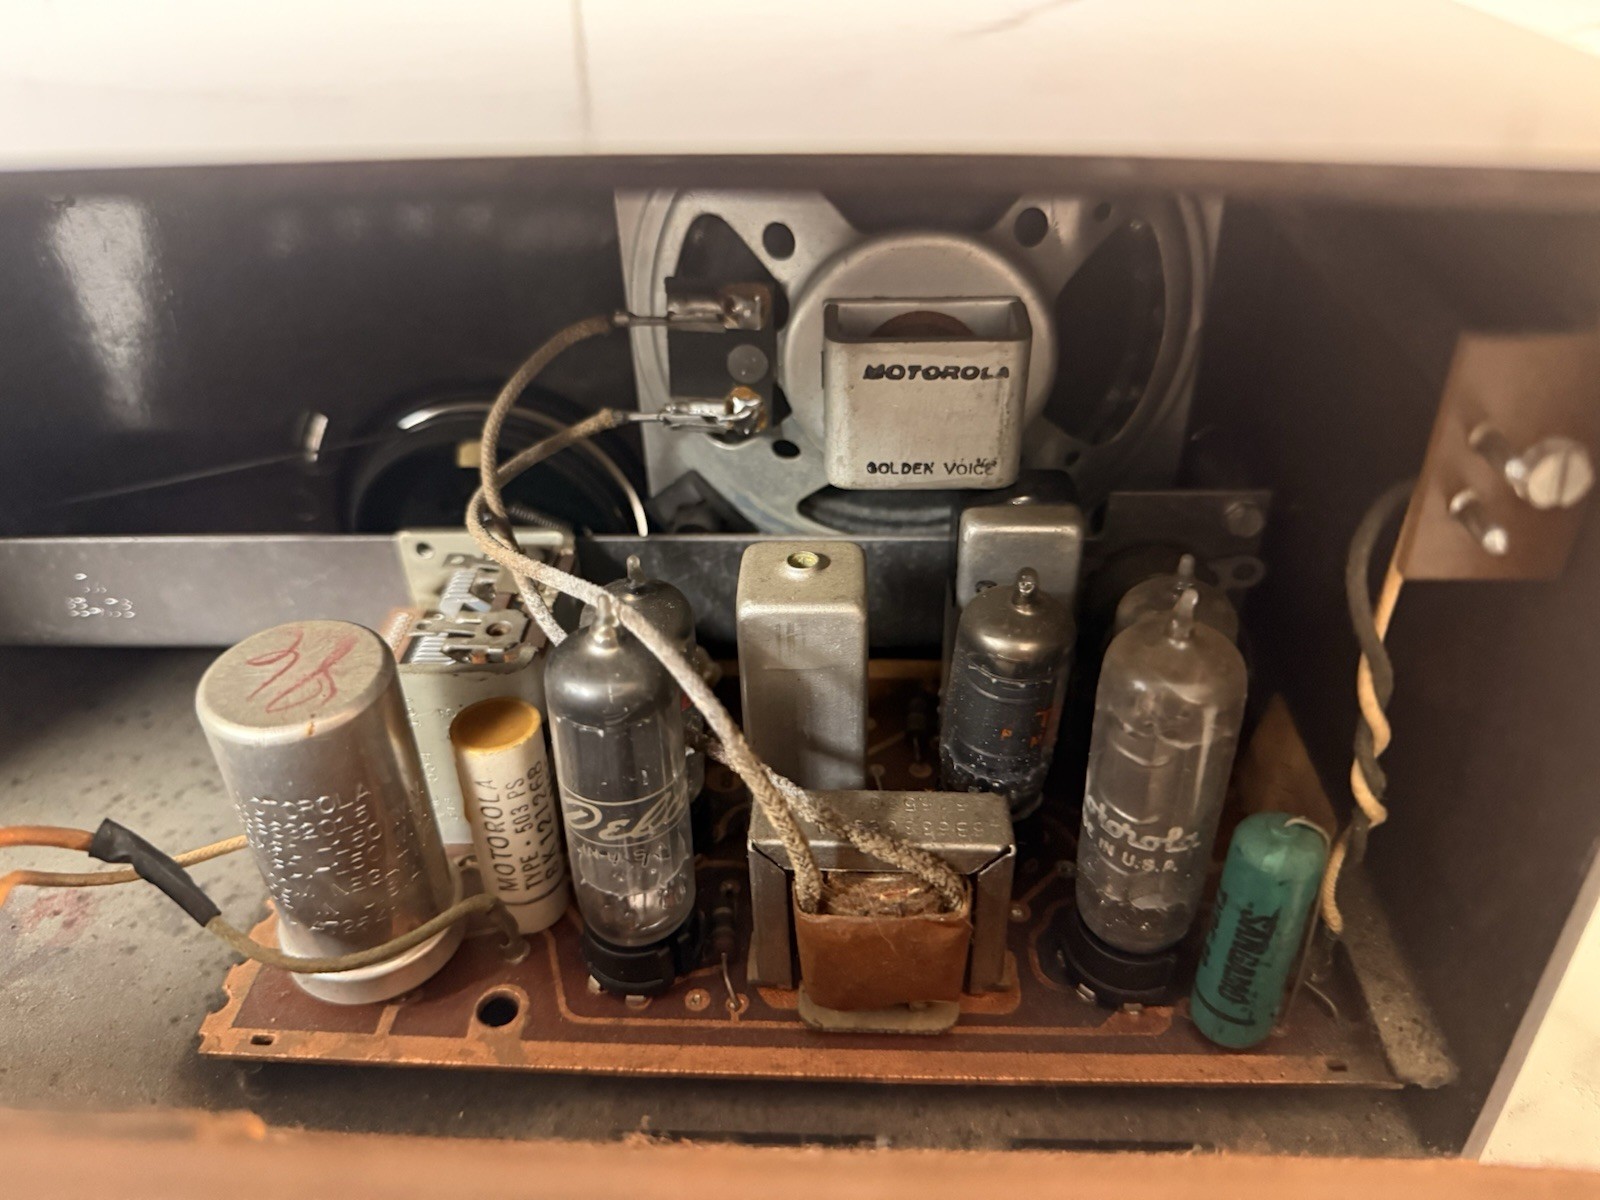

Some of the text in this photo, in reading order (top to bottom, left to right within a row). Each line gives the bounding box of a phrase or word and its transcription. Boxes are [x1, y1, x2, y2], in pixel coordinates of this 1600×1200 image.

[863, 364, 1010, 381] MOTOROLA
[866, 461, 996, 476] GOLDEN VOICE
[475, 779, 520, 892] MOTOROLA
[505, 777, 544, 891] TYPE 503 PS
[1099, 837, 1115, 857] IN
